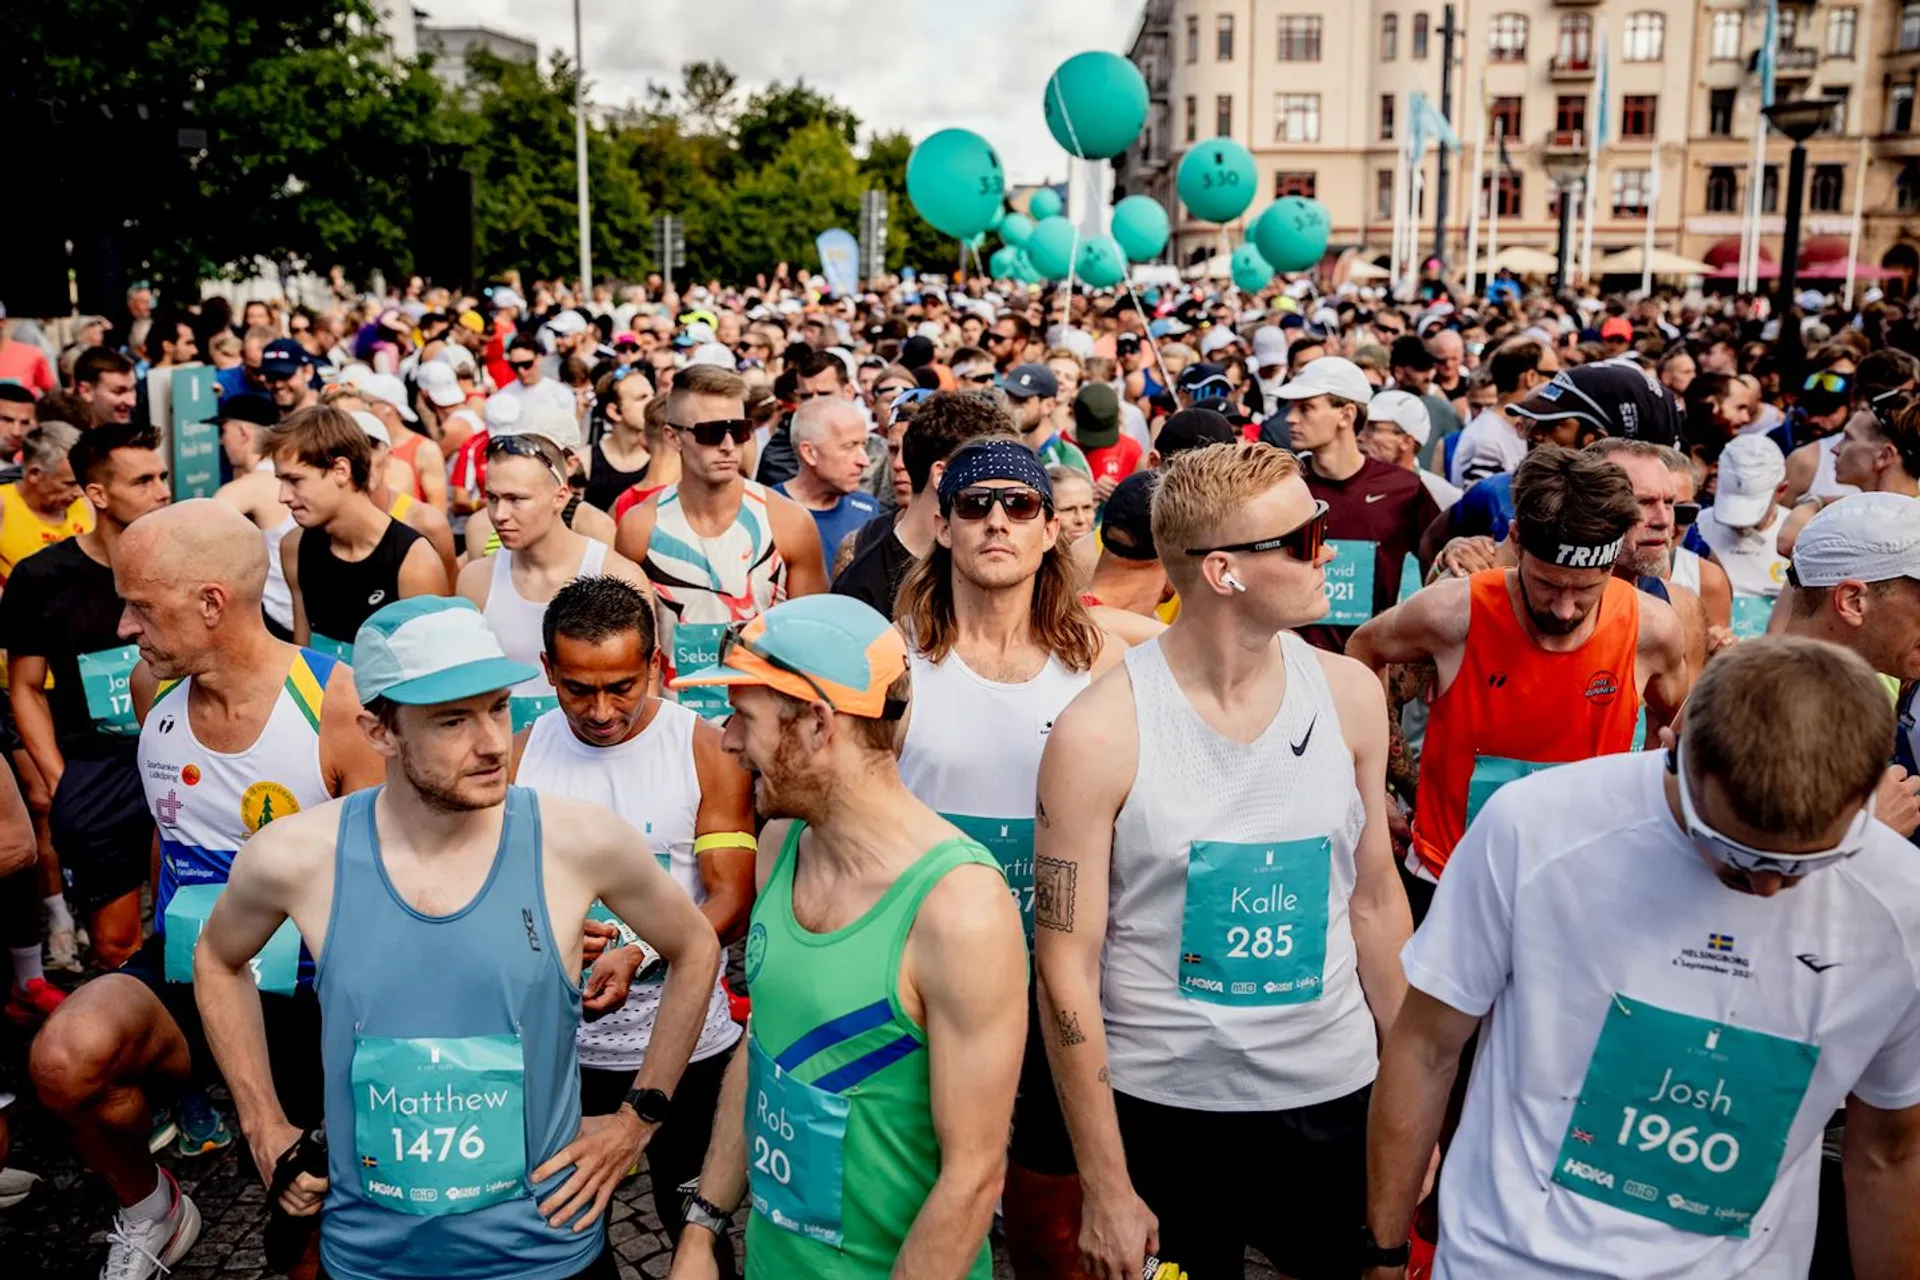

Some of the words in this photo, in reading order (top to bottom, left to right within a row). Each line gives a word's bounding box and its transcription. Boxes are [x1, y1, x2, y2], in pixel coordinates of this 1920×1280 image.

[1325, 561, 1355, 577] rvid
[1323, 581, 1354, 600] 021
[678, 646, 718, 663] Seba
[1231, 883, 1298, 913] Kalle
[1226, 924, 1293, 959] 285
[1681, 948, 1749, 967] HELSINGBORG
[1681, 959, 1729, 974] September
[1185, 976, 1224, 993] HOKA
[369, 1083, 508, 1115] Matthew
[1648, 1067, 1732, 1116] Josh
[757, 1089, 794, 1141] Rob
[391, 1124, 486, 1163] 1476
[1617, 1106, 1739, 1173] 1960
[754, 1135, 791, 1185] 20
[1562, 1158, 1615, 1190] HOKA
[369, 1180, 404, 1199] HOKA
